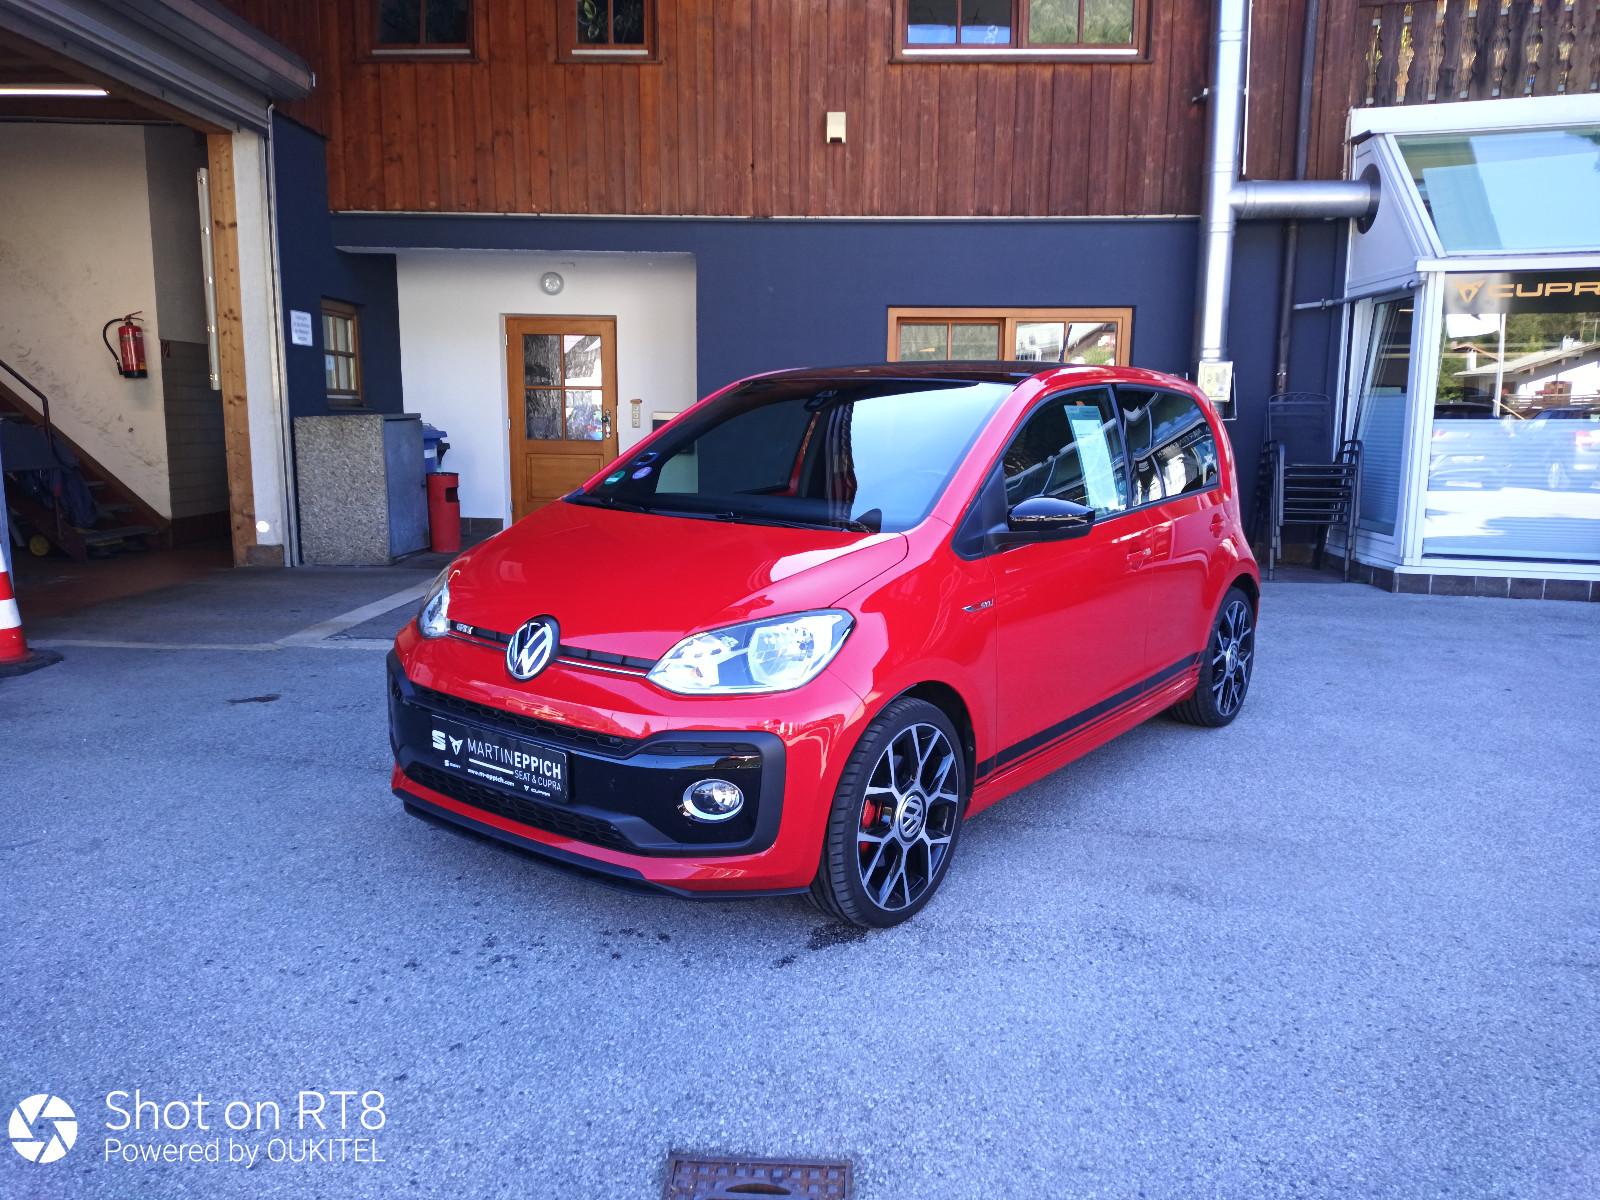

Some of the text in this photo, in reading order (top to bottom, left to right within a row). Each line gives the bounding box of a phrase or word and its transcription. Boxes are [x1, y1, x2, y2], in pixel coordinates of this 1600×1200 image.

[514, 769, 562, 792] SEAT & CUPRA
